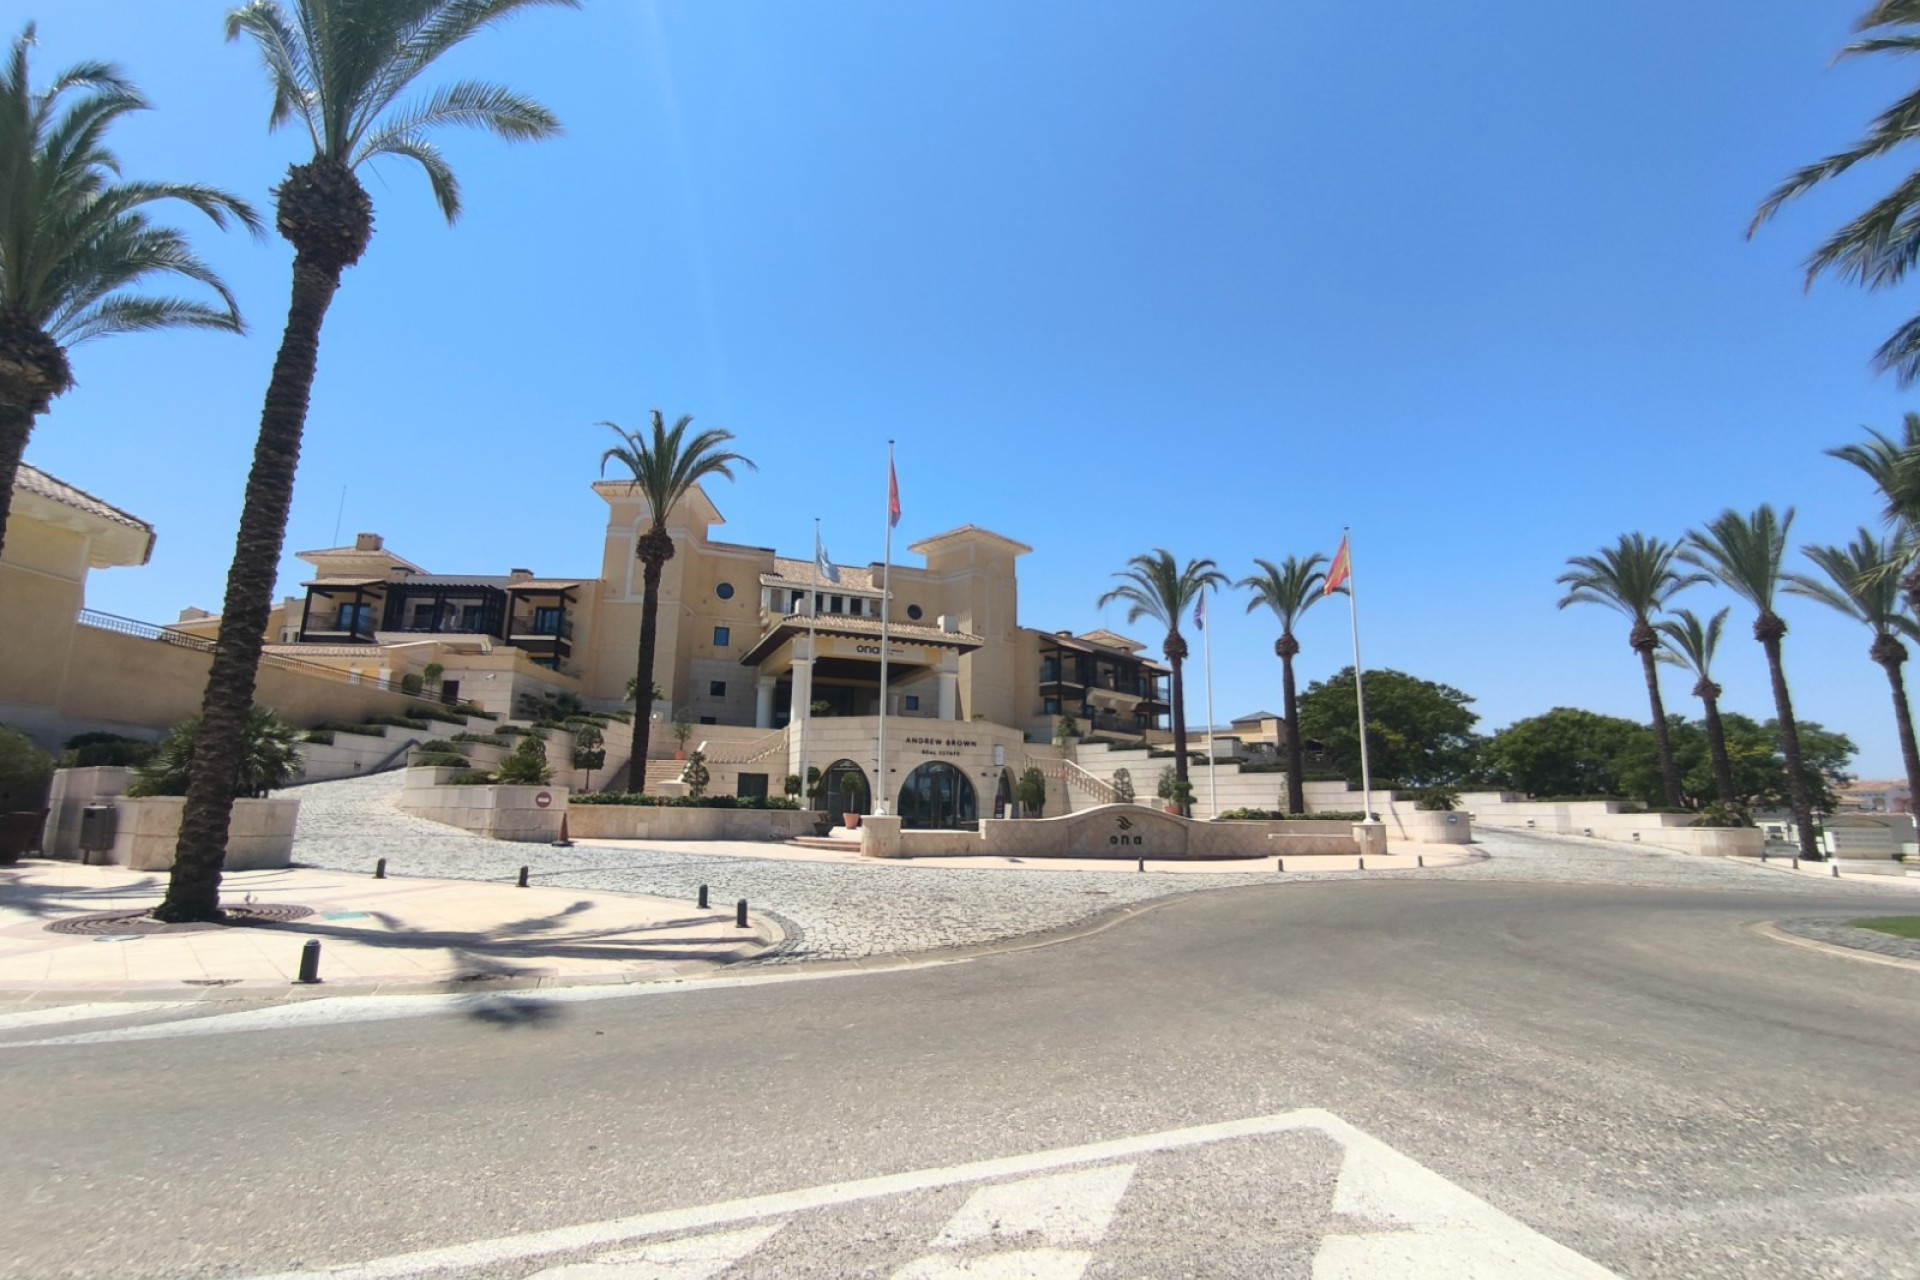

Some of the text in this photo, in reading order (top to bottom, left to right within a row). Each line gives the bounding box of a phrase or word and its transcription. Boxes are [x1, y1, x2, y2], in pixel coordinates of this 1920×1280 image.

[856, 645, 880, 654] ona
[905, 737, 977, 747] ANDREW BROWN
[1110, 835, 1142, 845] ona
